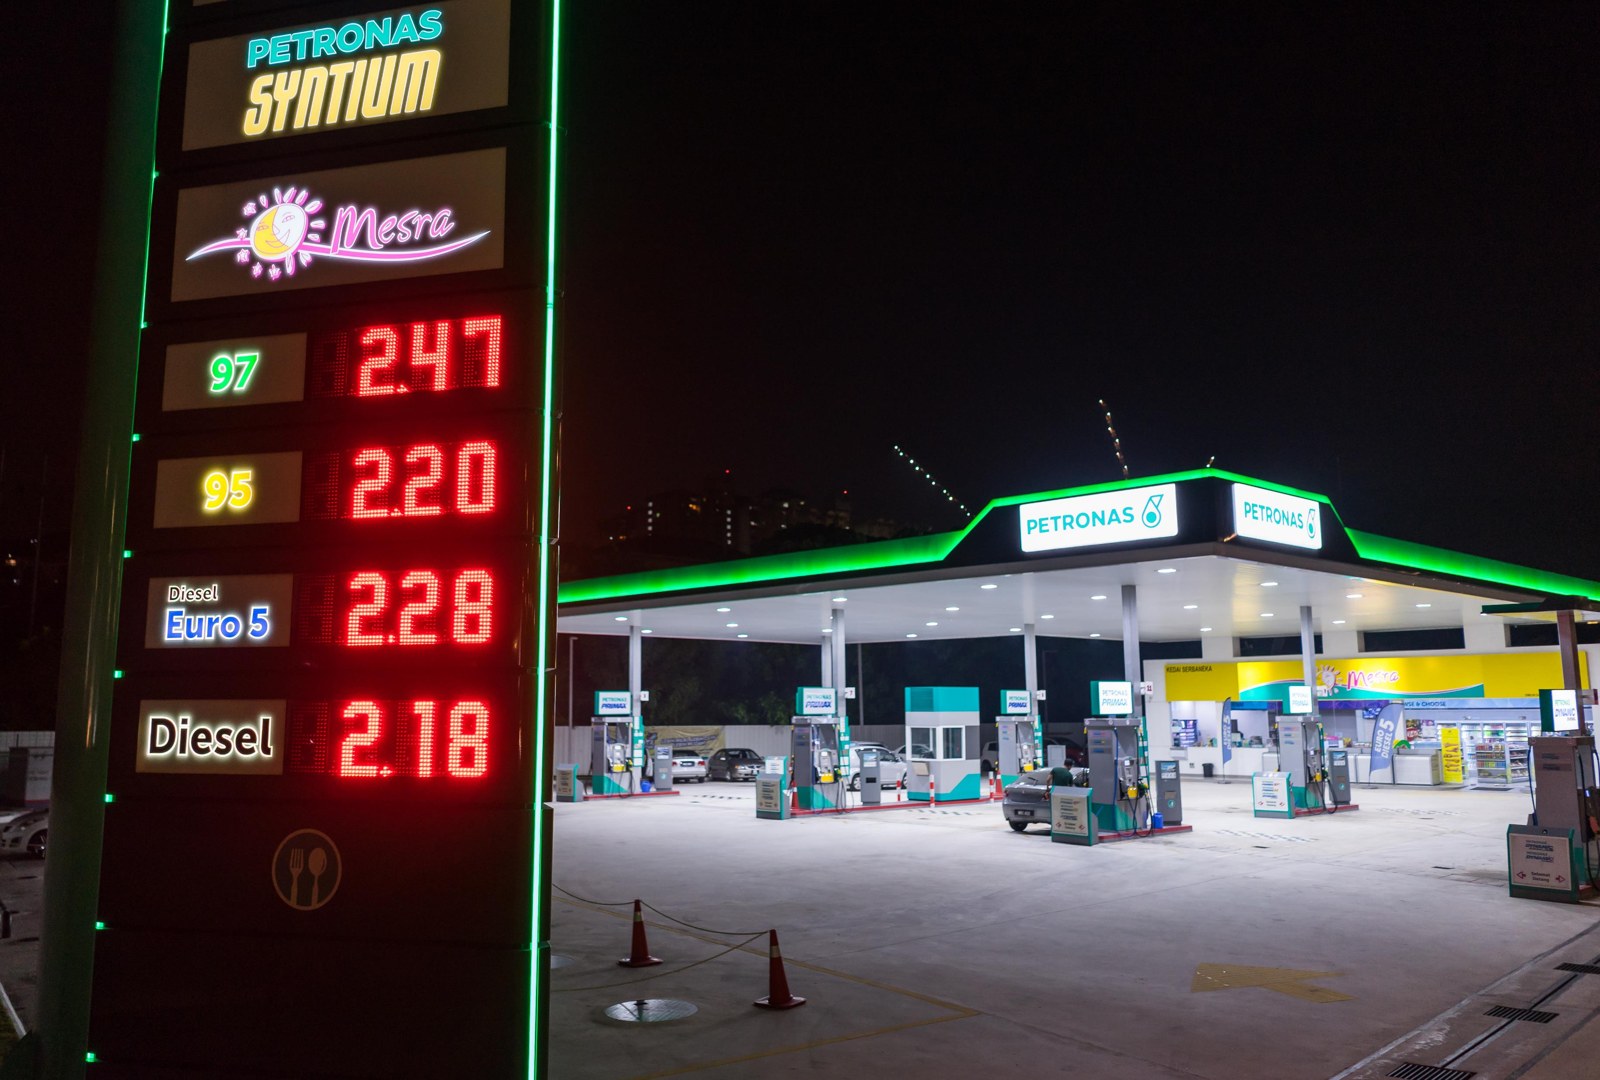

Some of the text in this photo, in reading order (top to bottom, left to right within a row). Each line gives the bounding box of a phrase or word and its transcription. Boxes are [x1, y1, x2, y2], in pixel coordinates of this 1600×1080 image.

[246, 9, 443, 68] PETRONAS
[242, 49, 441, 136] SYNTIUM
[330, 205, 455, 255] Mesra
[210, 352, 260, 391] 97
[358, 315, 502, 397] 2.47
[203, 470, 253, 510] 95
[352, 441, 496, 519] 2.20
[1027, 506, 1135, 535] PETRONAS
[1244, 501, 1304, 530] PETRONAS
[168, 584, 218, 602] Diesel
[347, 569, 493, 646] 2.28
[165, 606, 270, 640] Euro 5
[146, 716, 274, 758] Diesel
[340, 700, 490, 778] 2.18
[1374, 729, 1385, 753] EURO
[1380, 718, 1395, 733] 5
[1381, 732, 1393, 759] DIESEL
